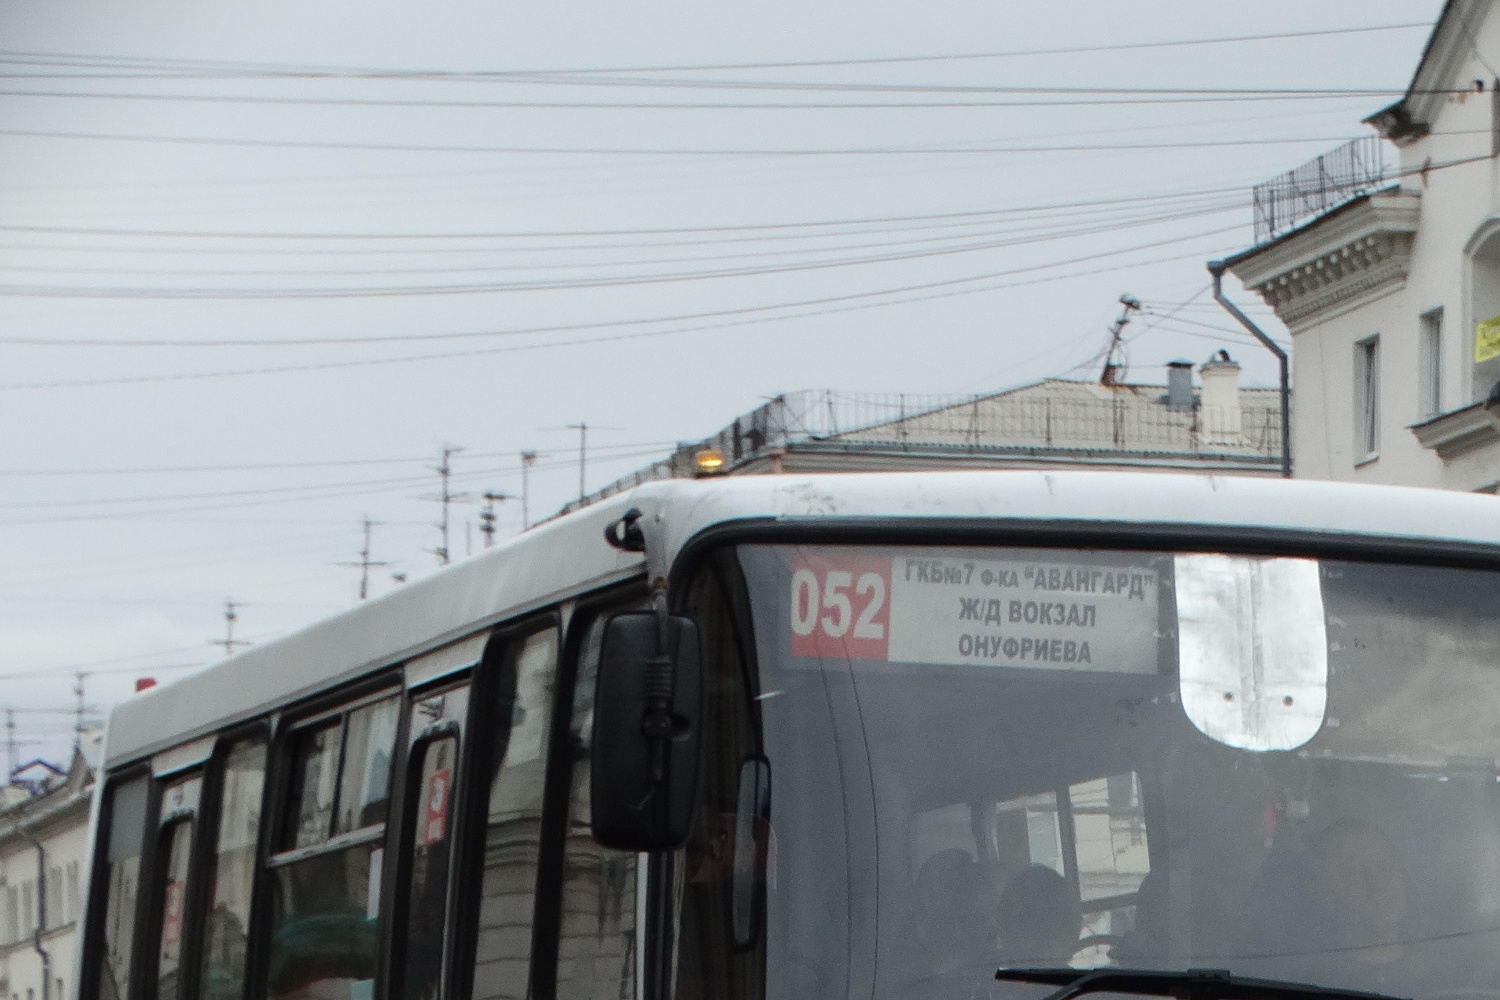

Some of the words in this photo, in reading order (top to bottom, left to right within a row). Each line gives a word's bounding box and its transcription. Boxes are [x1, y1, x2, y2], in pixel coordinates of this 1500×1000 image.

[904, 560, 975, 585] ГКБ№7
[789, 568, 885, 640] 052
[958, 596, 1001, 627] Ж/Д
[1008, 600, 1097, 628] ВОКЗАЛ
[957, 633, 1093, 664] ОНУФРИЕВА
